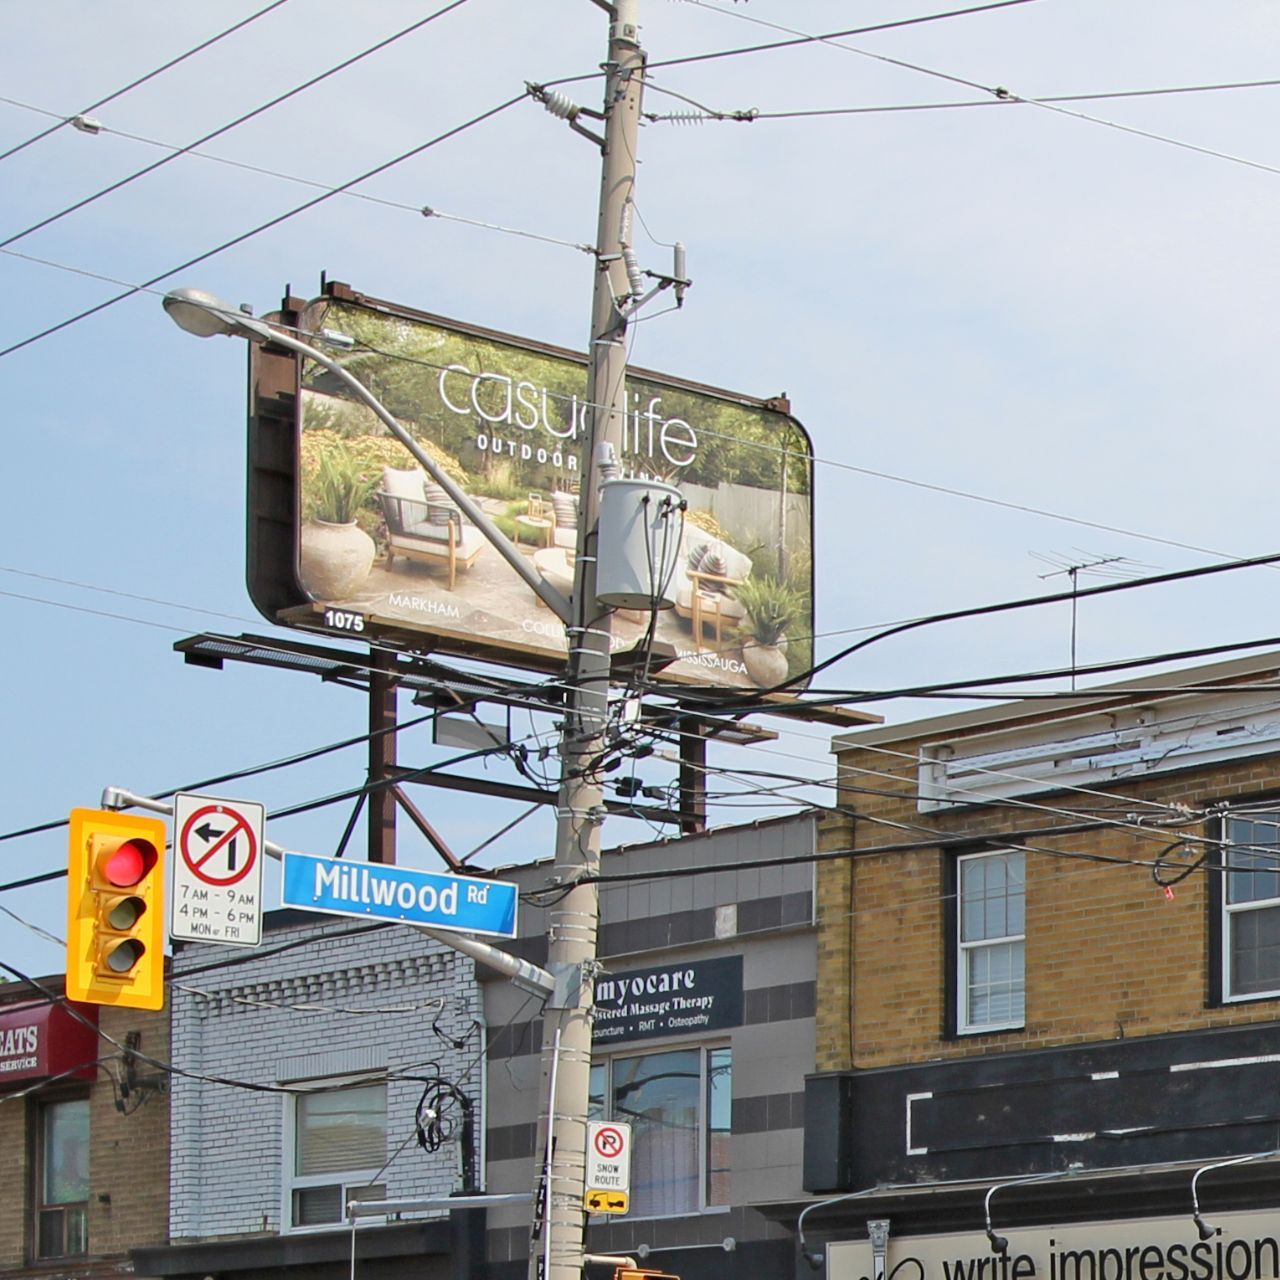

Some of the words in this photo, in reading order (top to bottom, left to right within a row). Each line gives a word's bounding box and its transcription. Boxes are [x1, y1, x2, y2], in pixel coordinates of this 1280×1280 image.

[439, 365, 698, 467] casulife
[477, 434, 577, 471] OUTDOOR
[388, 593, 460, 618] MARKHAM
[325, 610, 365, 632] 1075
[180, 884, 189, 899] 7
[192, 889, 208, 901] AM
[227, 889, 236, 903] 9
[238, 894, 254, 906] AM
[315, 862, 458, 915] Millwood
[467, 886, 488, 905] Rd
[179, 903, 188, 917] 4
[192, 907, 208, 918] PM
[227, 908, 236, 922] 6
[238, 912, 254, 924] PM
[190, 922, 211, 935] MON
[224, 925, 240, 938] FRI
[596, 969, 696, 1006] myocare
[630, 1000, 671, 1016] Massage
[672, 996, 715, 1010] Therapy
[638, 1019, 656, 1032] RMT
[668, 1013, 710, 1029] Osteopathy
[0, 1056, 37, 1072] SERVICE
[596, 1163, 620, 1173] SNOW
[594, 1175, 620, 1186] ROUTE
